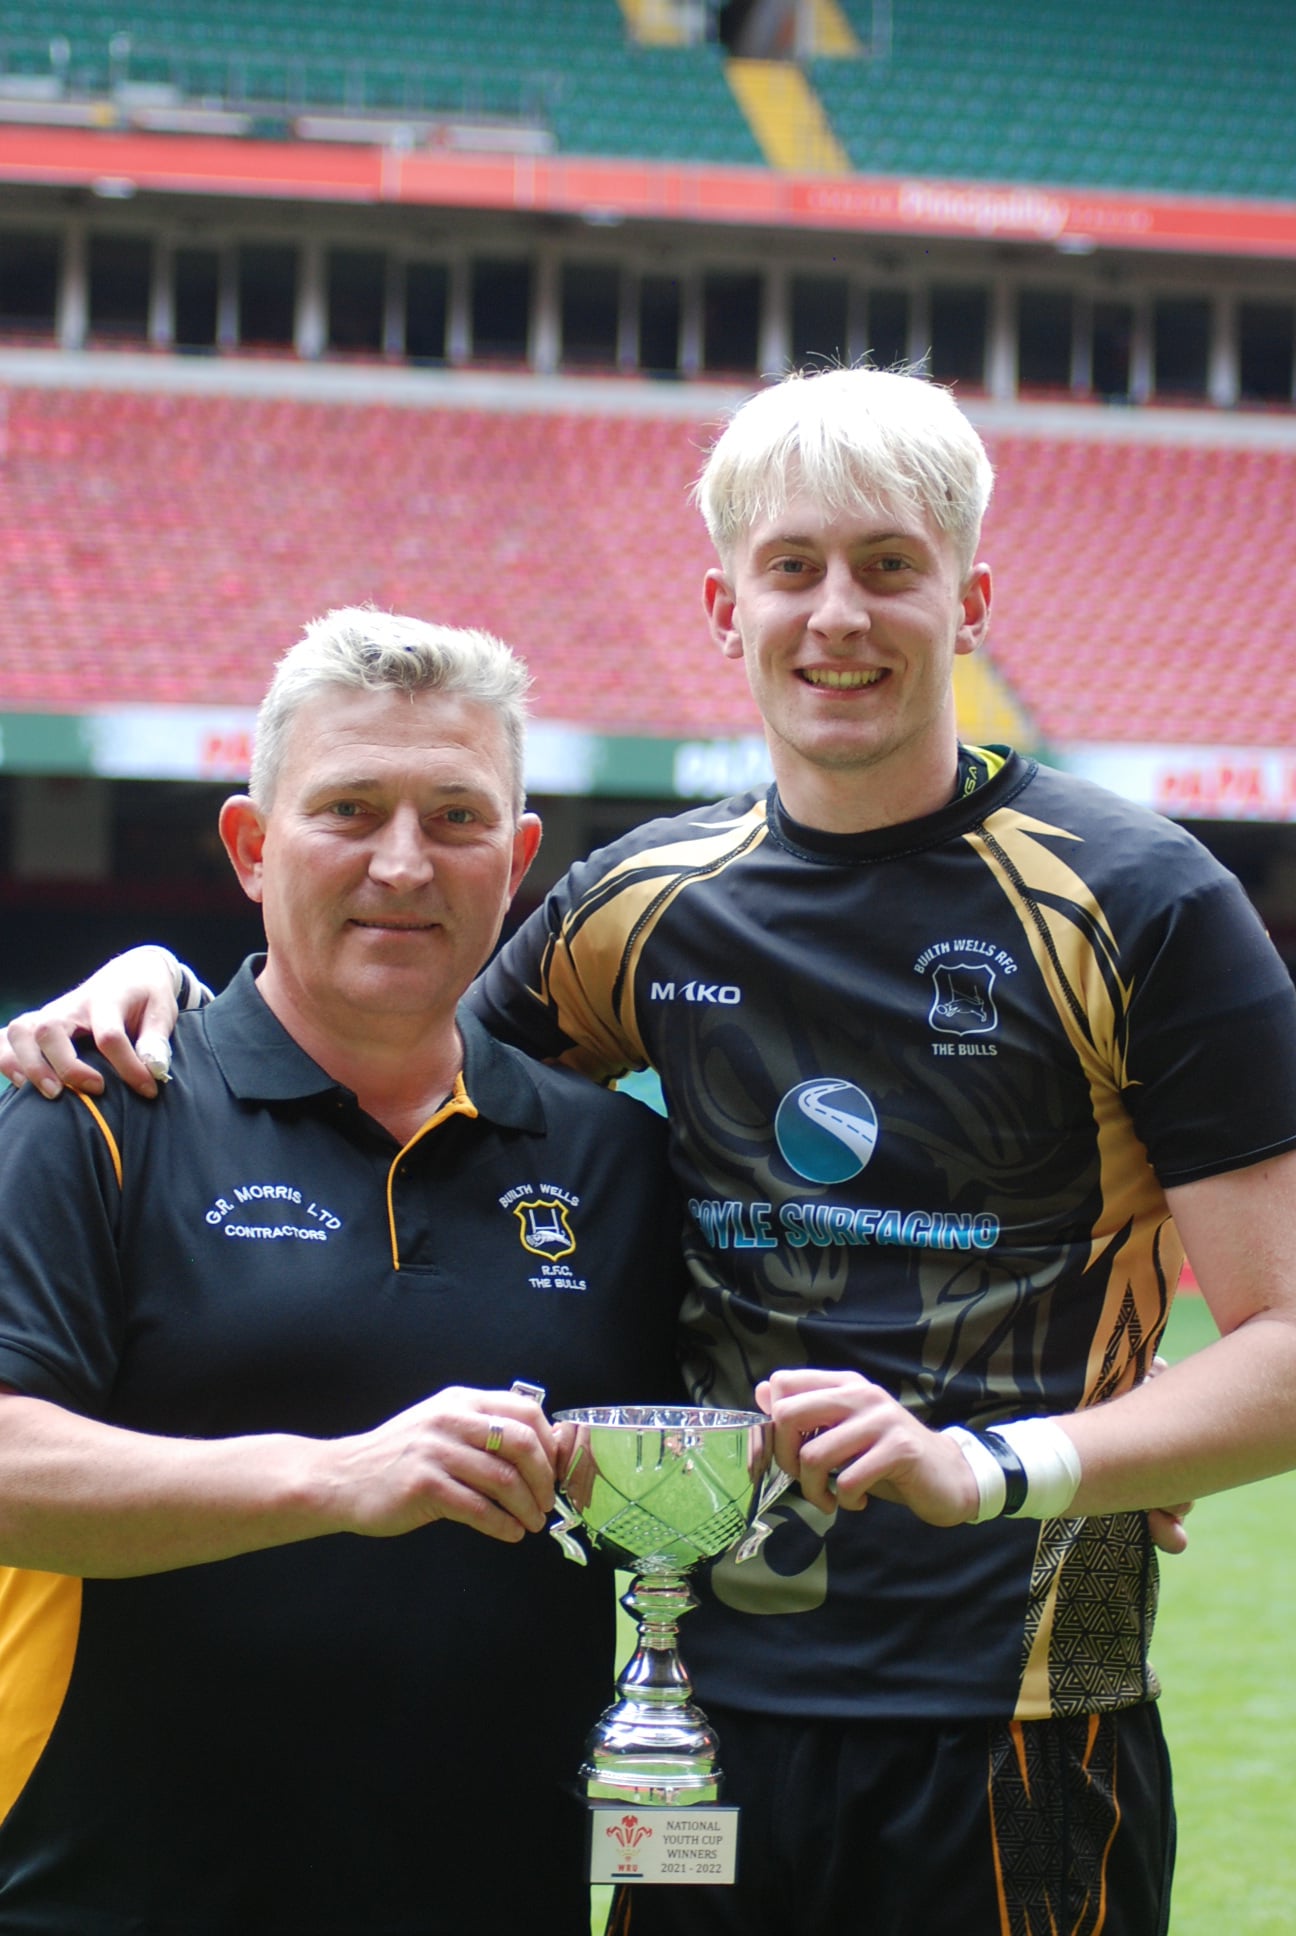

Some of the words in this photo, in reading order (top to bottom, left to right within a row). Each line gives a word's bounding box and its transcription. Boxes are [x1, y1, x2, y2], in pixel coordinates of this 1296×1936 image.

[913, 941, 951, 975] BUILTH
[953, 939, 997, 958] WELLS
[994, 950, 1019, 975] RFC
[931, 1043, 956, 1056] THE
[958, 1043, 999, 1057] BULLS
[498, 1183, 534, 1209] BUILTH
[539, 1183, 580, 1207] WELLS
[233, 1185, 303, 1204] MORRIS
[306, 1202, 342, 1230] LTD
[224, 1224, 328, 1242] CONTRACTORS
[528, 1278, 553, 1289] THE
[554, 1278, 587, 1291] BULLS
[666, 1820, 721, 1831] NATIONAL
[662, 1834, 699, 1845] YOUTH
[701, 1834, 723, 1846] CUP
[667, 1848, 718, 1860] WINNERS
[660, 1862, 686, 1874] 2021
[696, 1862, 722, 1874] 2022
